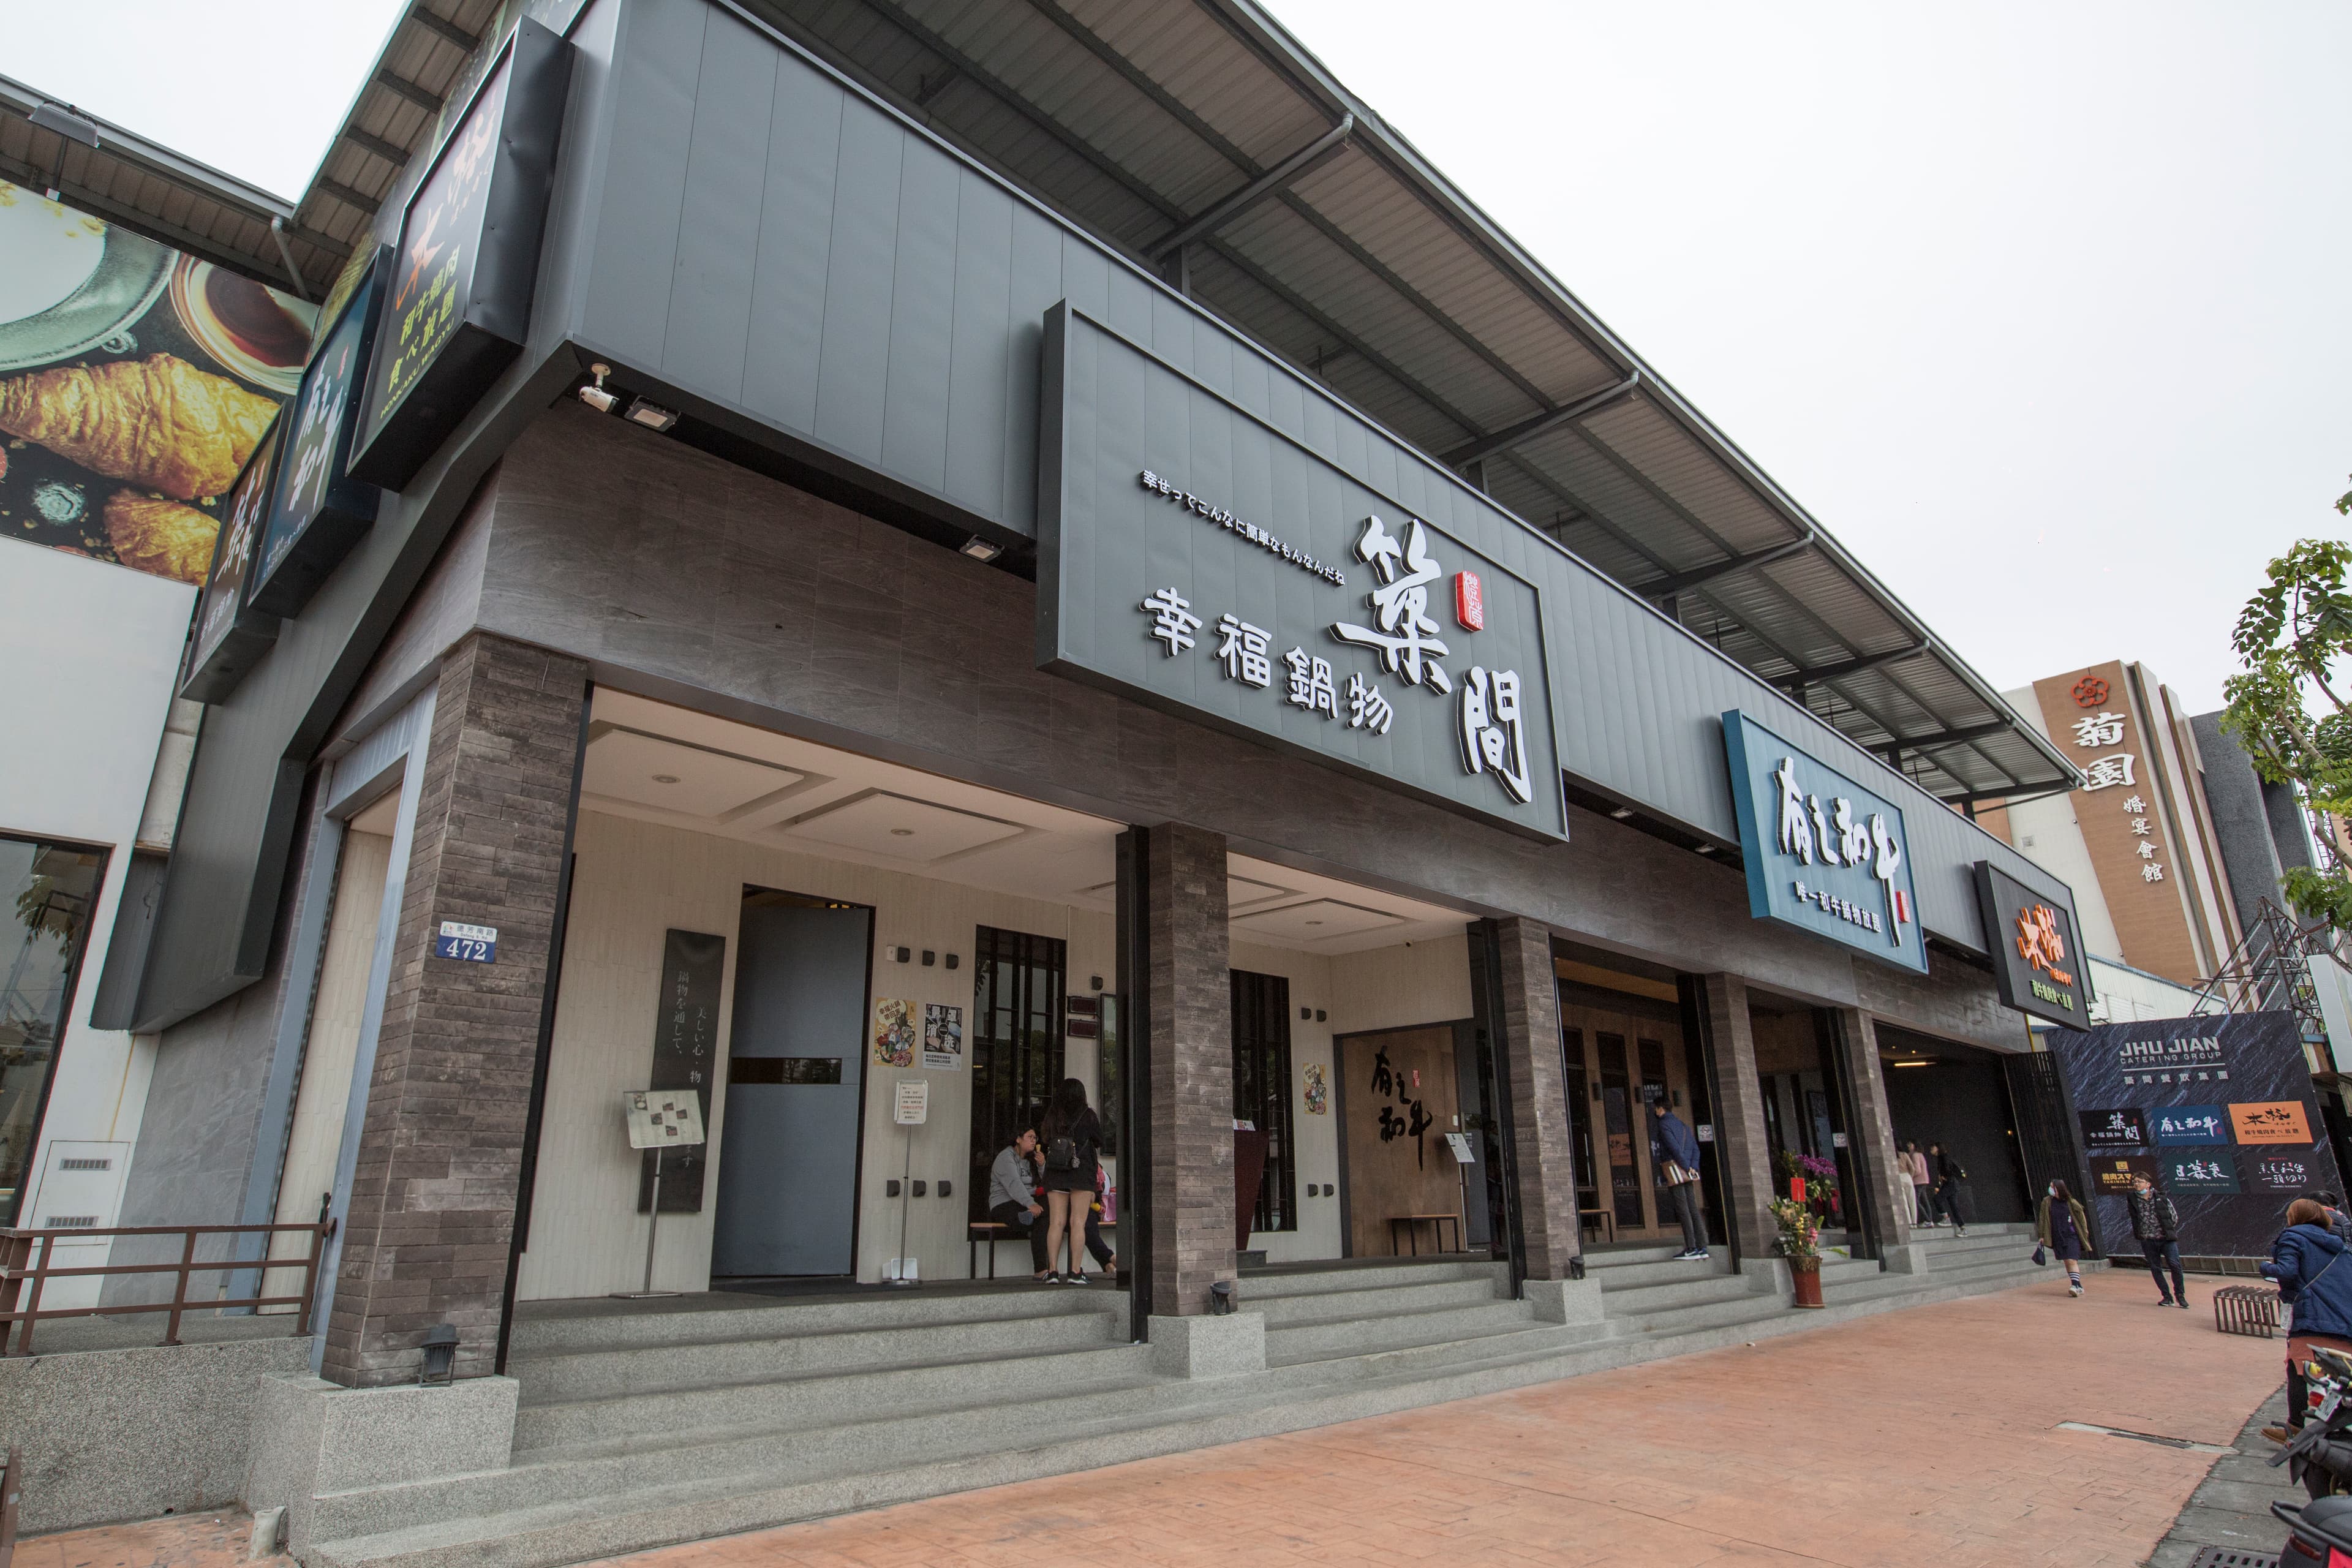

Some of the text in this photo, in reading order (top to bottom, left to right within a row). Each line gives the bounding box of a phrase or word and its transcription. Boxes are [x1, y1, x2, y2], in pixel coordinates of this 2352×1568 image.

[388, 279, 458, 394] 食べ放題
[399, 244, 461, 346] 和牛燒肉
[380, 316, 454, 420] HONKAKU WAGYU
[1140, 469, 1346, 586] 幸せってこんなに簡単なもんなんだね
[1140, 587, 1394, 736] 幸福鍋物
[1329, 515, 1533, 804] 築間
[2070, 712, 2136, 792] 菊園
[2123, 795, 2164, 883] 婚宴會館
[446, 938, 487, 960] 472
[2119, 1036, 2220, 1057] JHU JIAN
[2120, 1052, 2222, 1065] CATERING GROUP
[2124, 1071, 2229, 1085] 築間餐飲集團
